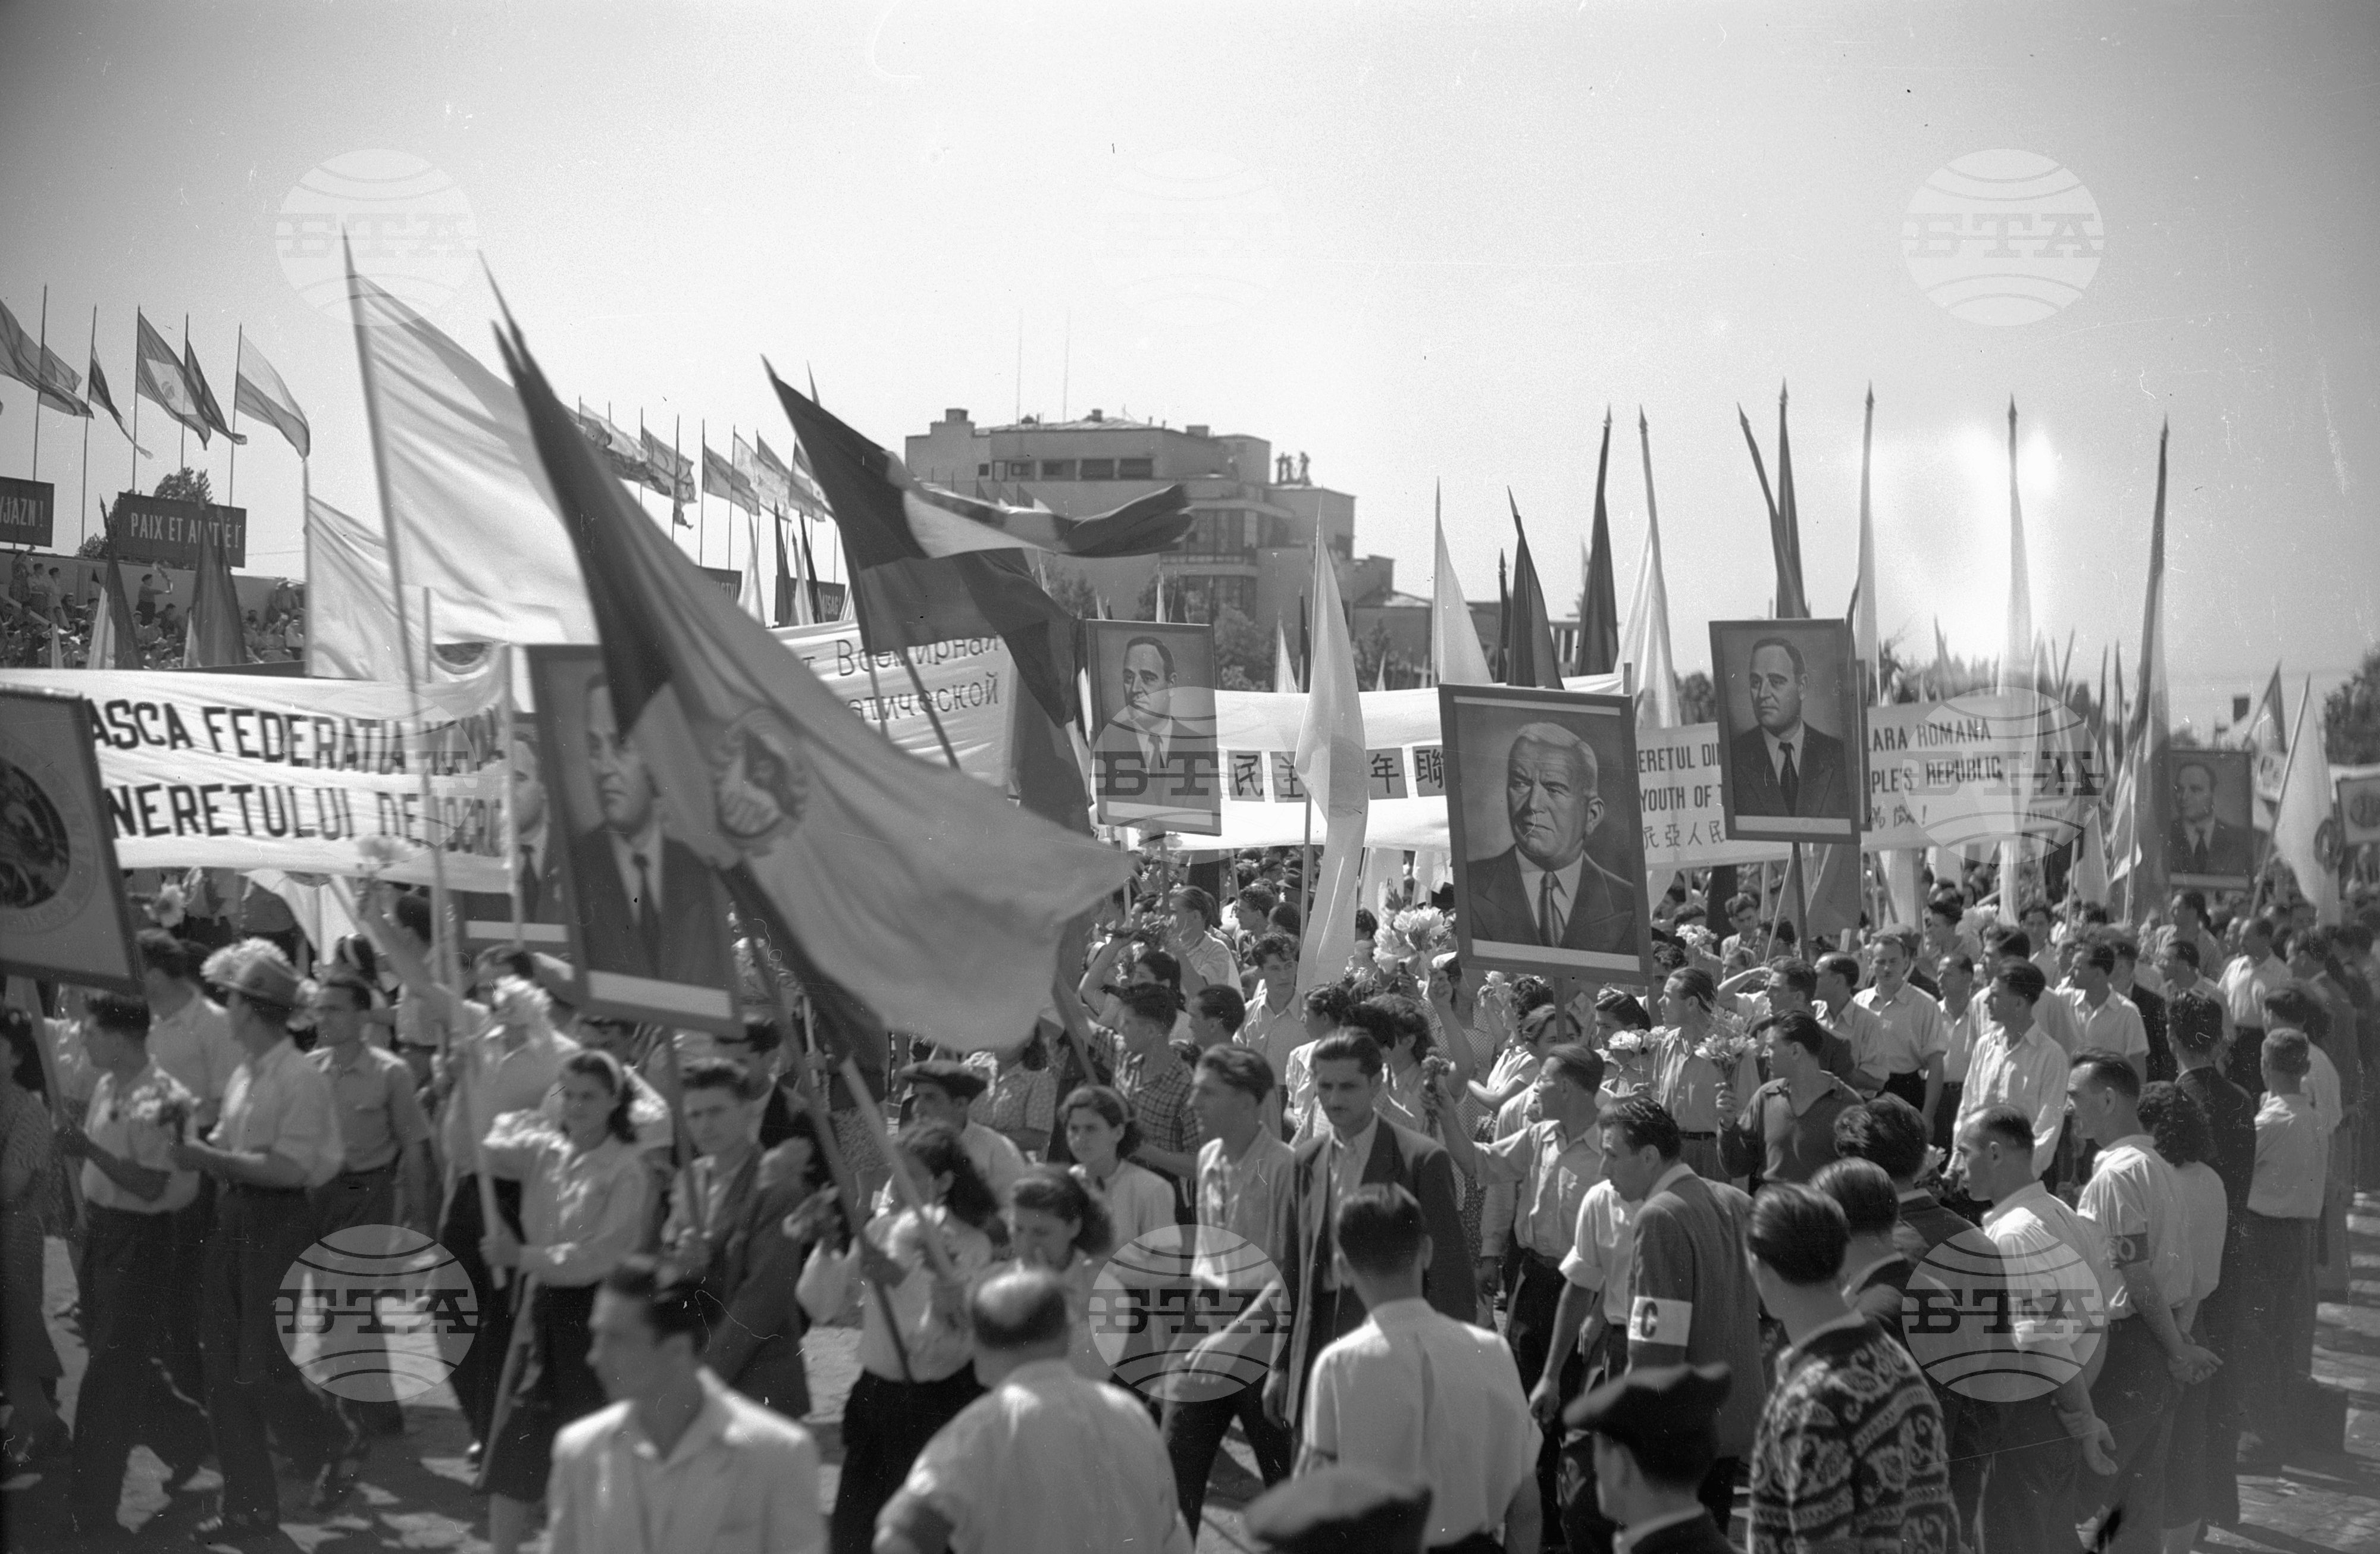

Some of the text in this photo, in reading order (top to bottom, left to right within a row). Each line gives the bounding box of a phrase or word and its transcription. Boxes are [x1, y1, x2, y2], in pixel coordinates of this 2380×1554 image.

[131, 512, 162, 540] PAIX
[169, 516, 183, 542] ET
[1637, 745, 1695, 773] ERETUL
[1640, 785, 1686, 813] YOUTH
[1695, 784, 1712, 808] OF
[1640, 1301, 1659, 1339] C
